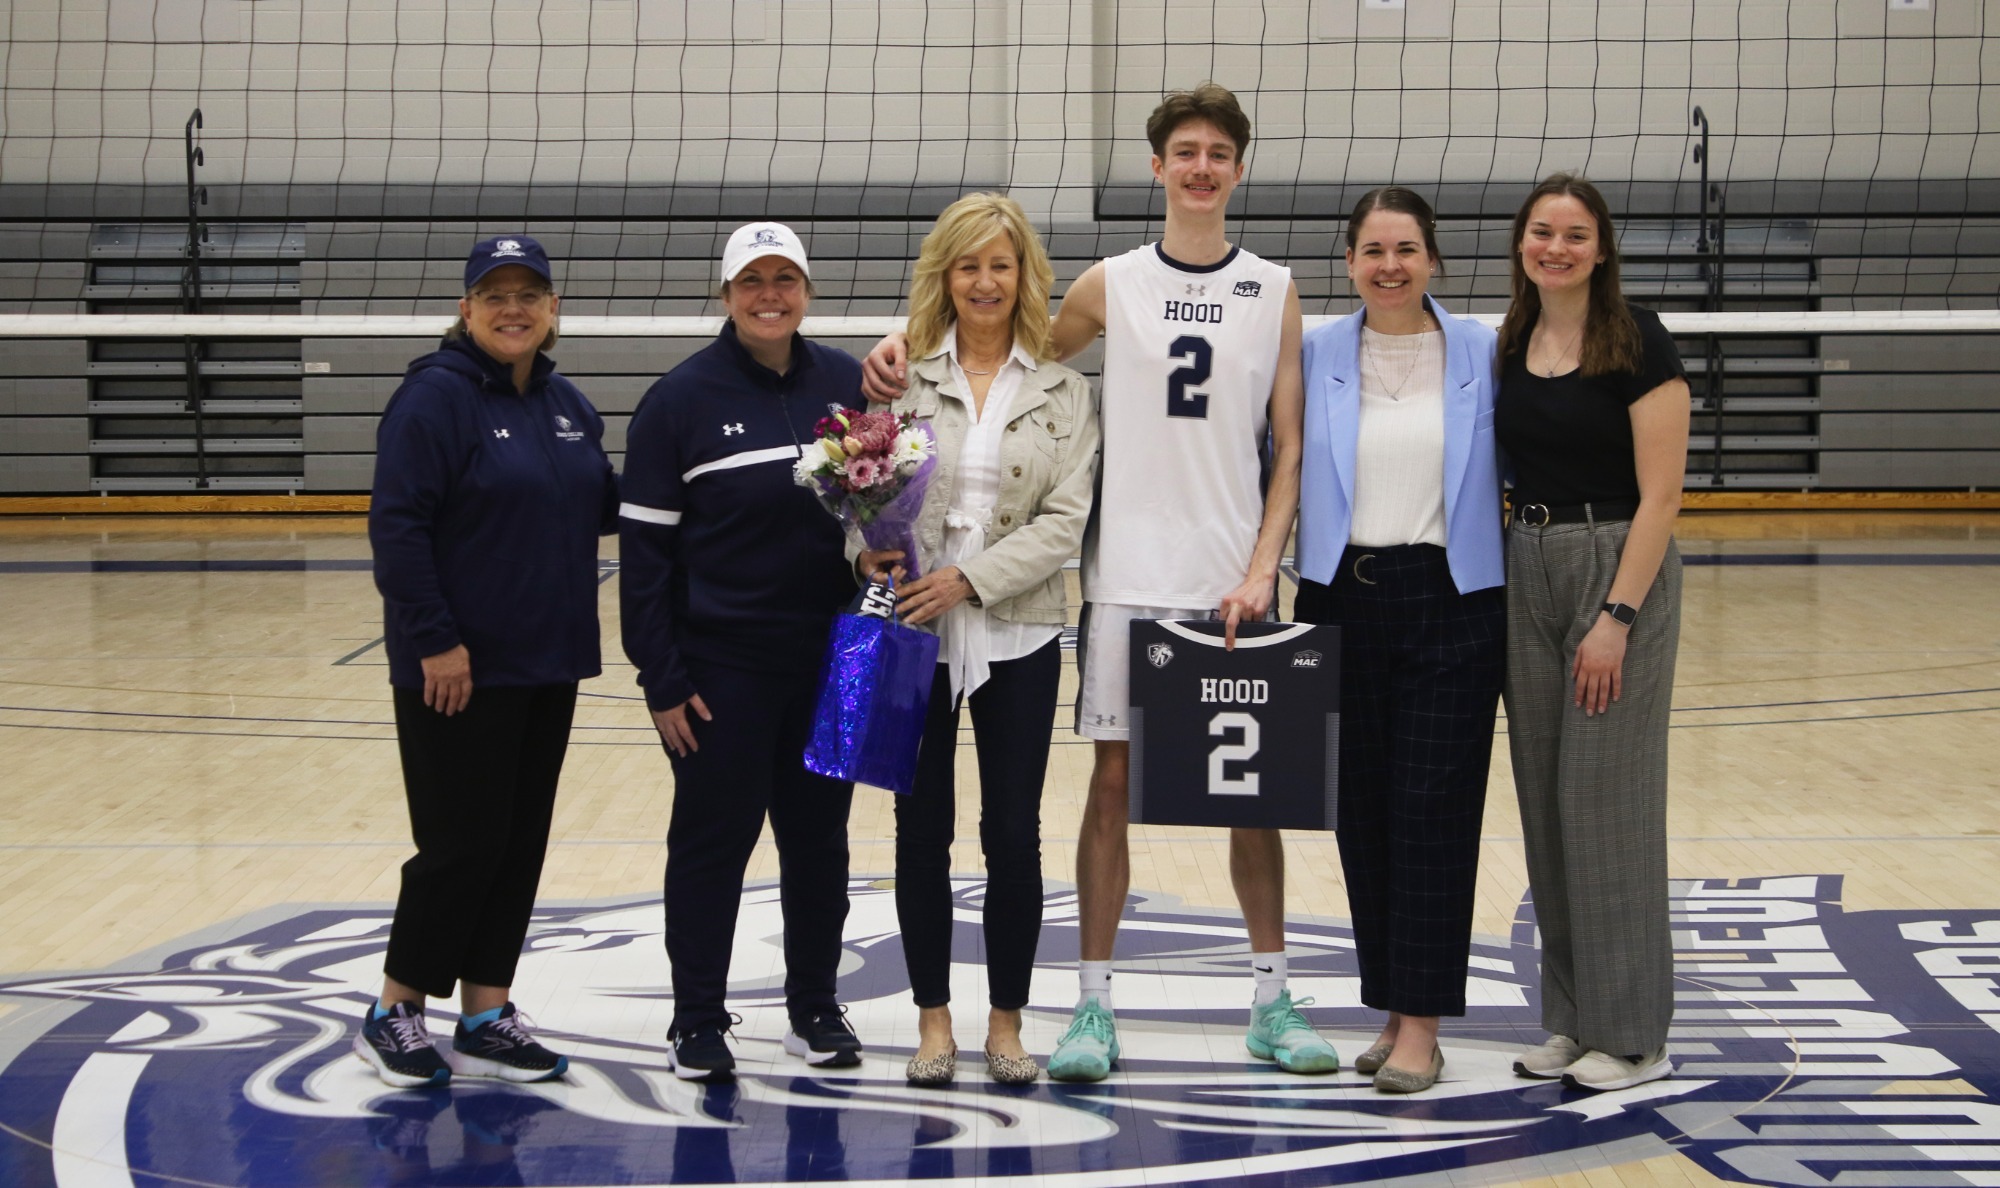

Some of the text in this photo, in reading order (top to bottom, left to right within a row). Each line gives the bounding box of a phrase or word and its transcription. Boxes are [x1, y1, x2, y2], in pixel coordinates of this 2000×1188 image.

[1164, 301, 1222, 323] HOOD
[1166, 333, 1214, 420] 2
[1293, 658, 1318, 666] MAC
[1200, 678, 1269, 704] HOOD
[1208, 712, 1260, 796] 2
